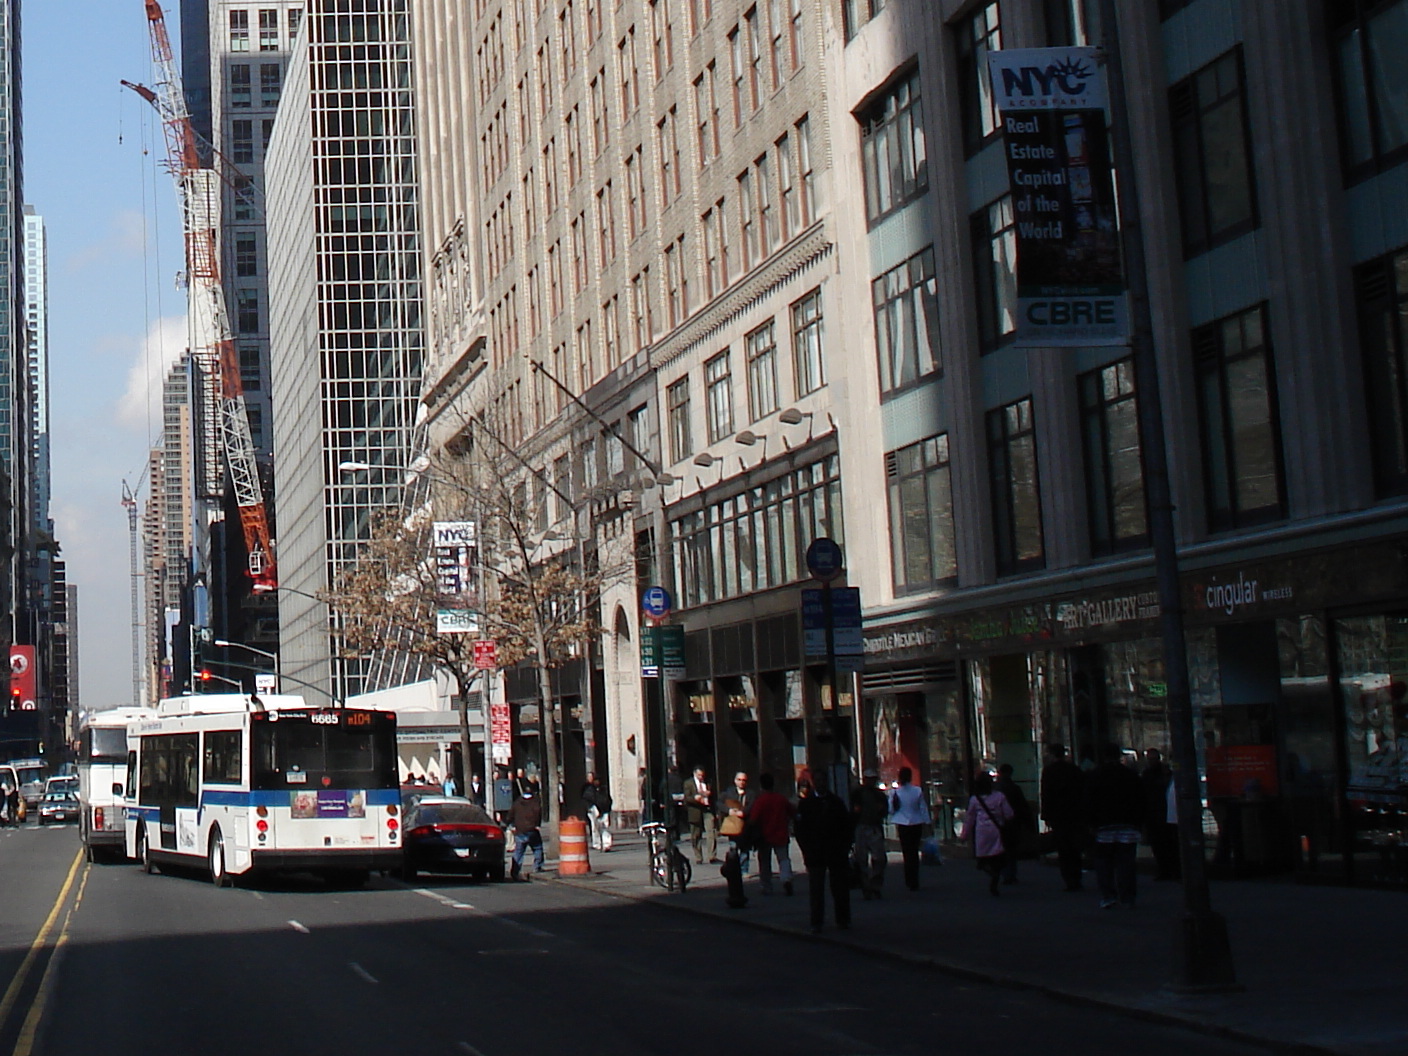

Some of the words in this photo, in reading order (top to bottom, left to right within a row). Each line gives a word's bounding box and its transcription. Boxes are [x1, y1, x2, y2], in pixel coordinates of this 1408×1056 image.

[1001, 58, 1091, 97] NYC
[1006, 116, 1040, 134] Real
[1010, 142, 1056, 160] Estate
[1013, 167, 1067, 189] Capital
[1017, 194, 1032, 212] of
[1034, 194, 1060, 212] the
[1019, 220, 1063, 239] World
[1026, 300, 1116, 325] CBRE
[1206, 571, 1259, 615] cingular
[1087, 595, 1137, 625] GALLERY
